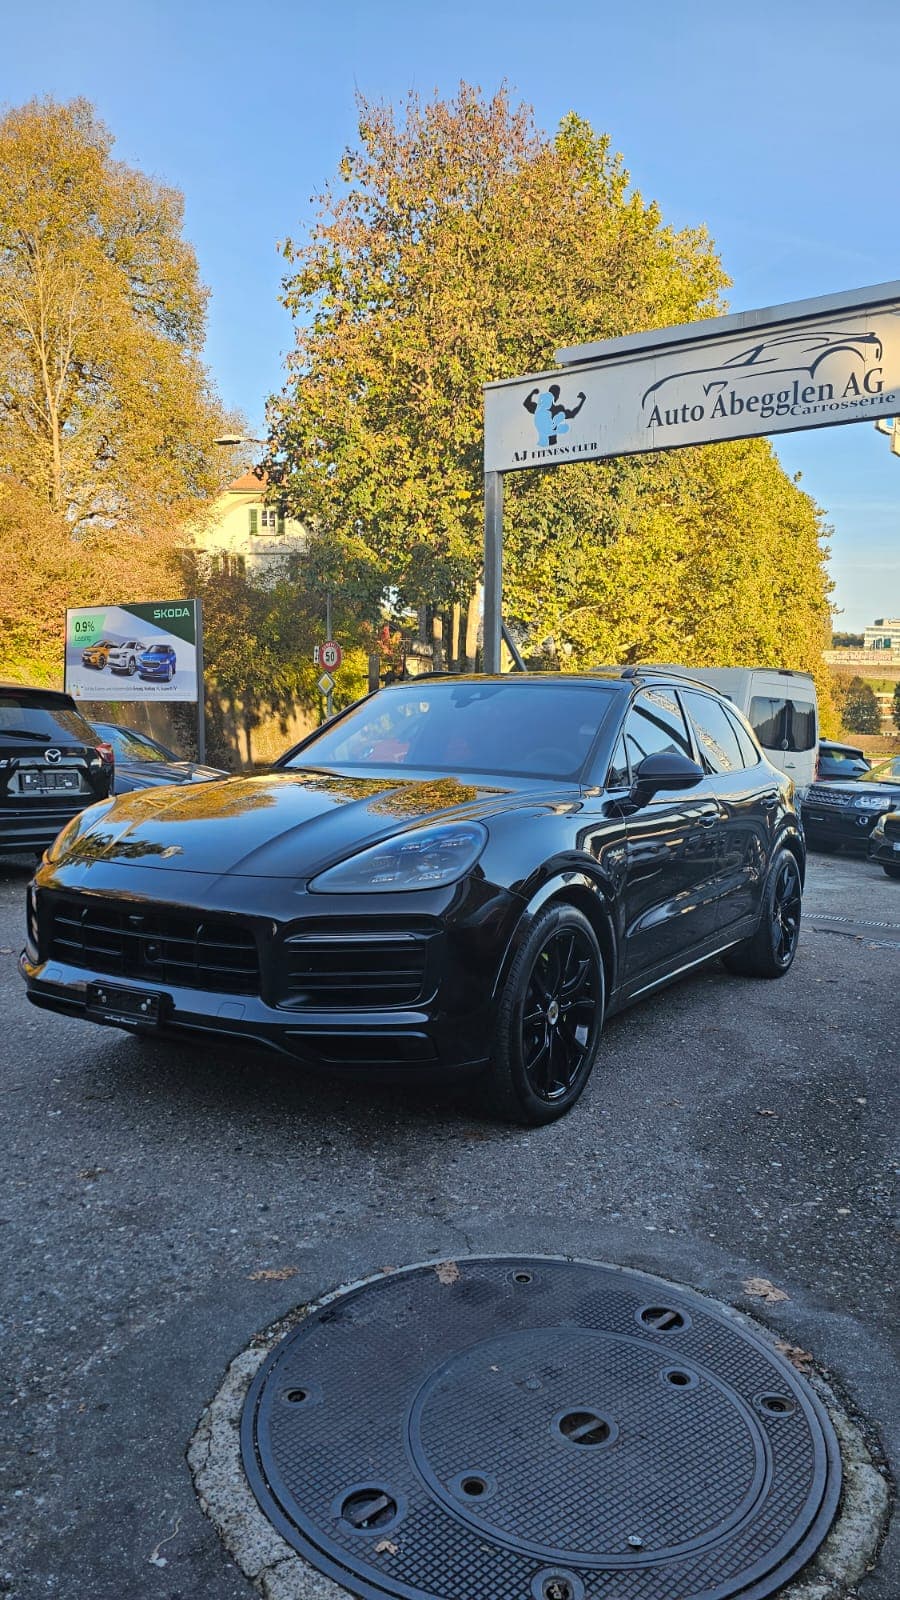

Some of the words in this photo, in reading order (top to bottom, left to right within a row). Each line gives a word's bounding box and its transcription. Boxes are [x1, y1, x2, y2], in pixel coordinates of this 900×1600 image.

[646, 404, 705, 428] Auto
[710, 380, 834, 418] Abegglen
[841, 367, 885, 398] AG
[790, 393, 896, 416] Carrosserie
[512, 450, 528, 462] AJ
[531, 446, 570, 459] FITNESS
[572, 442, 598, 453] CLUB
[325, 651, 335, 662] 50
